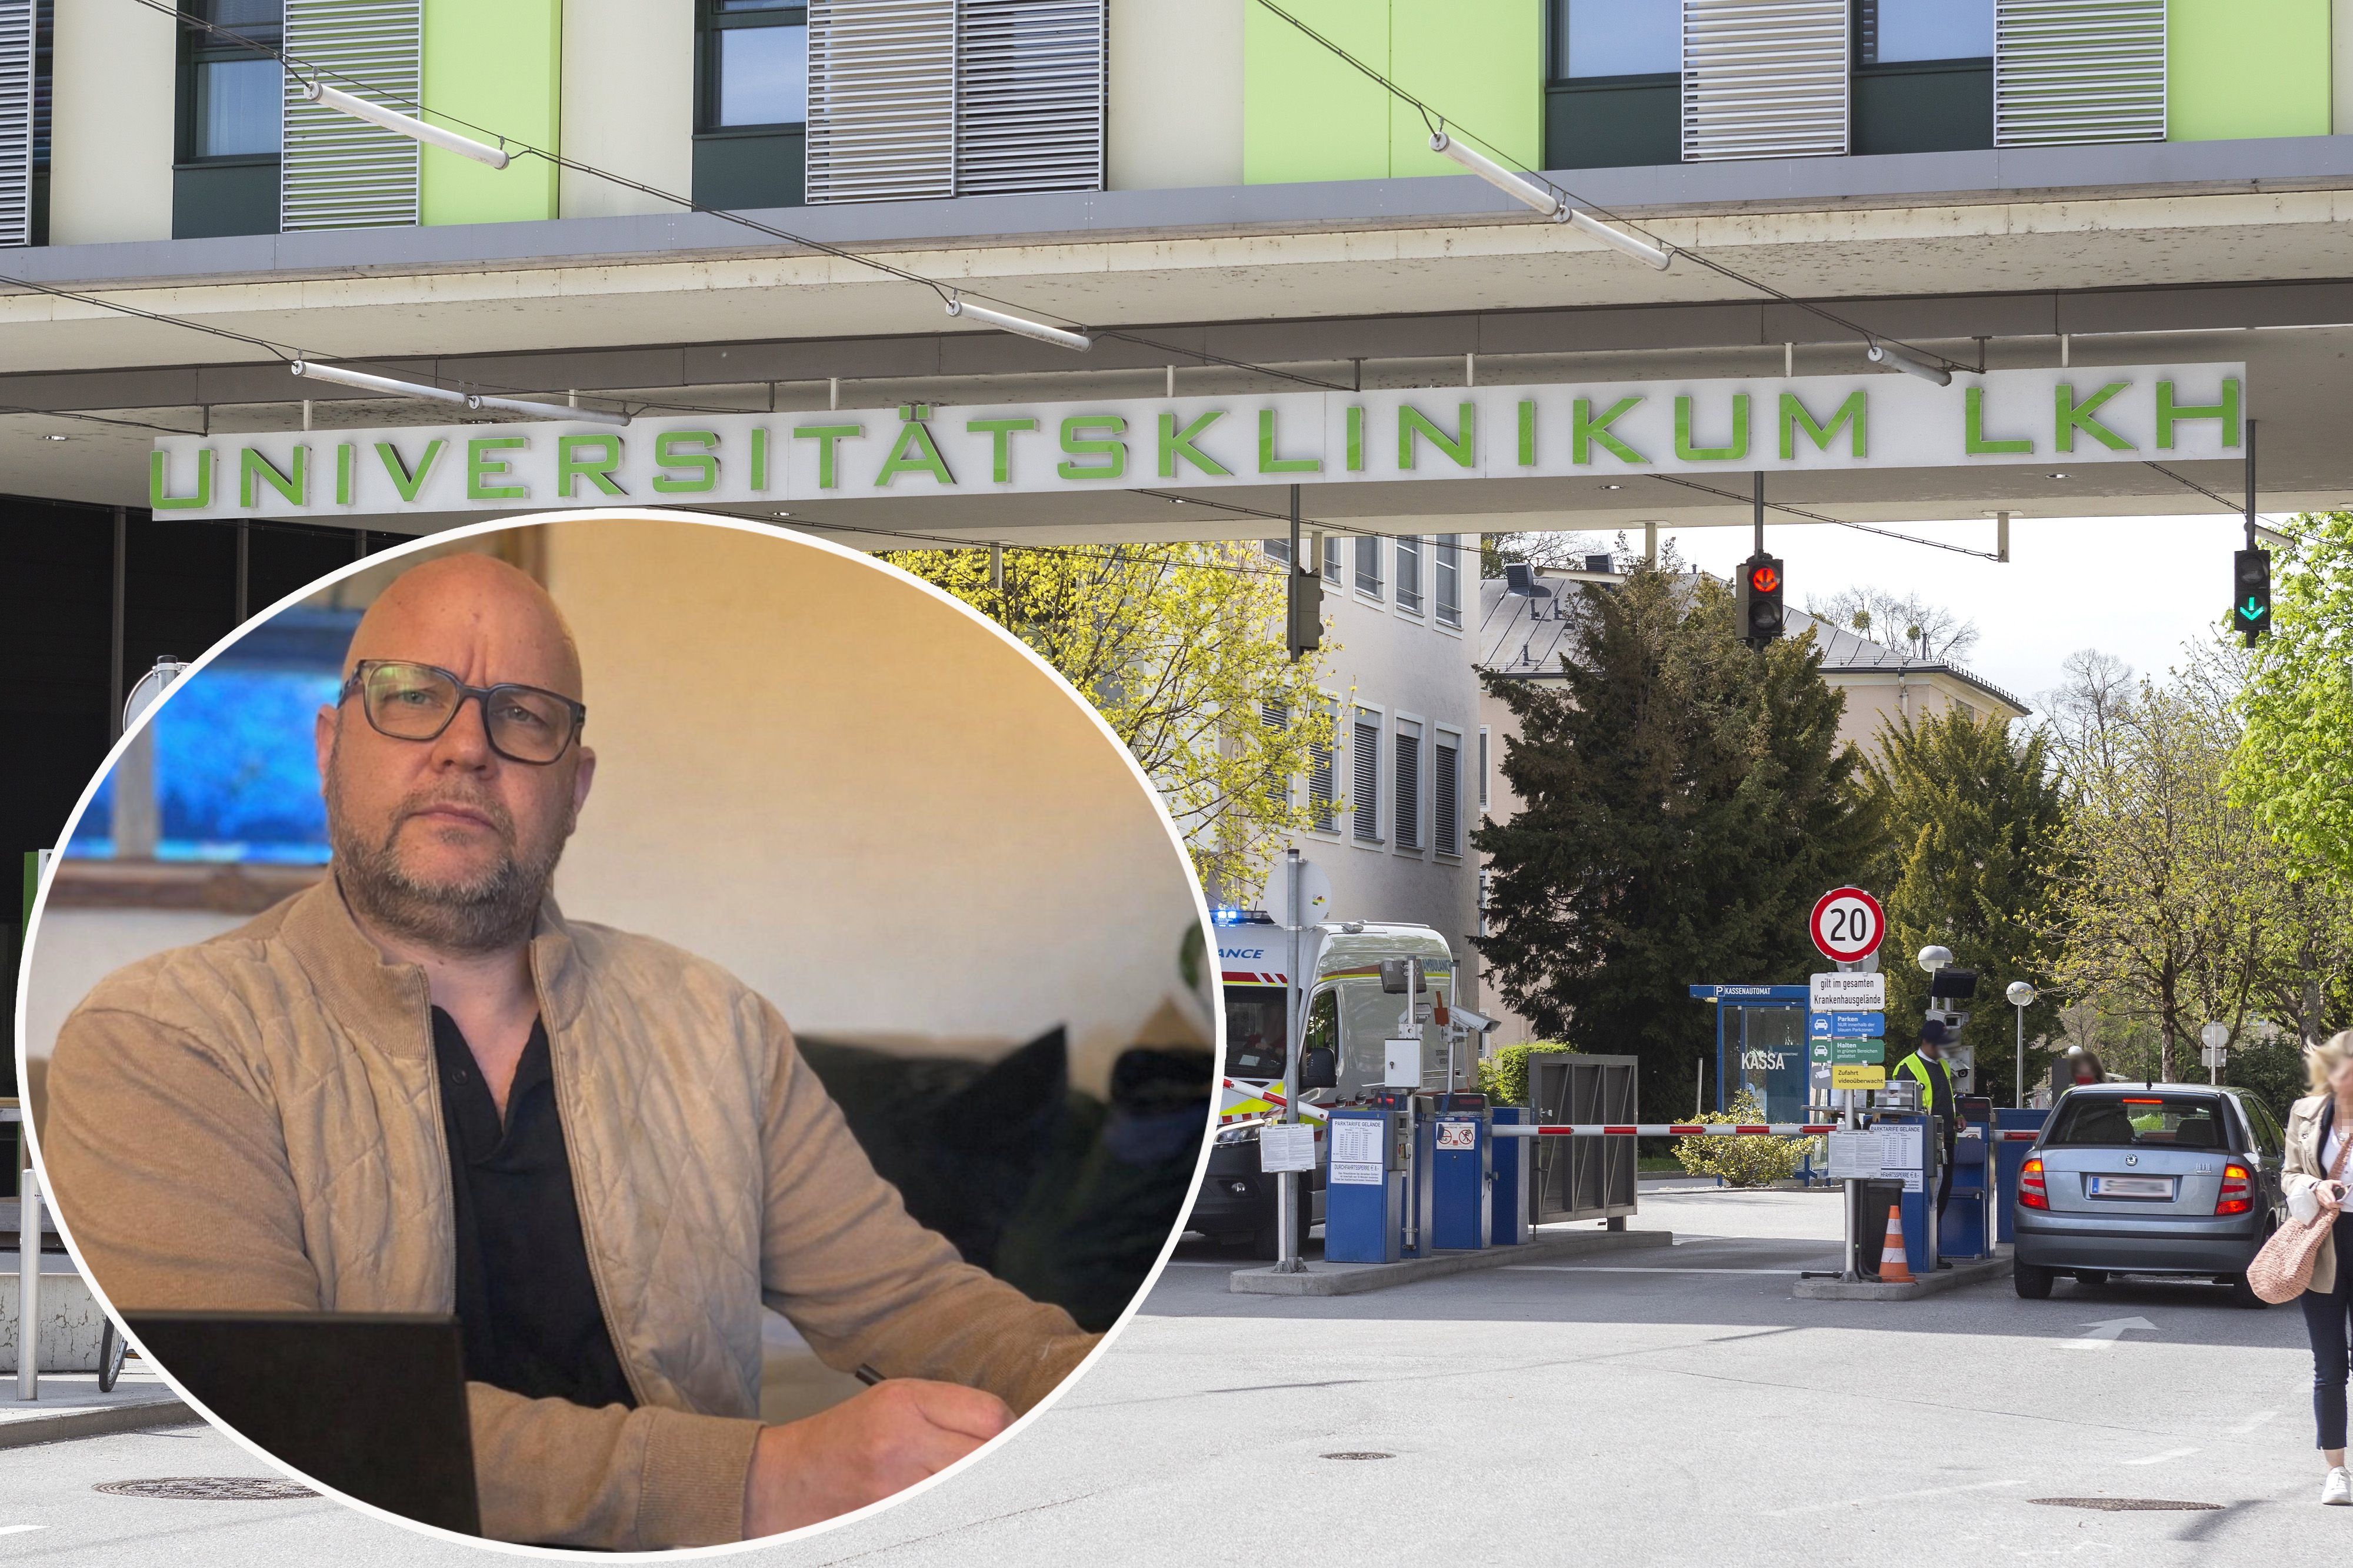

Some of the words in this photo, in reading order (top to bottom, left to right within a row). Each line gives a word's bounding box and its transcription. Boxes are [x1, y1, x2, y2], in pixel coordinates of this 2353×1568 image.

[150, 390, 1867, 510] UNIVERSITÄTSKLINIKUM
[1965, 378, 2239, 455] LKH
[1830, 908, 1867, 942] 20
[1218, 949, 1264, 959] ANCE
[1421, 959, 1450, 972] AMBULANC
[1821, 978, 1831, 990] gilt
[1833, 979, 1841, 988] im
[1843, 979, 1874, 990] gesamten
[1715, 986, 1724, 995] P
[1814, 994, 1881, 1006] Krankenhausgelände
[1741, 1052, 1785, 1070] KASSA
